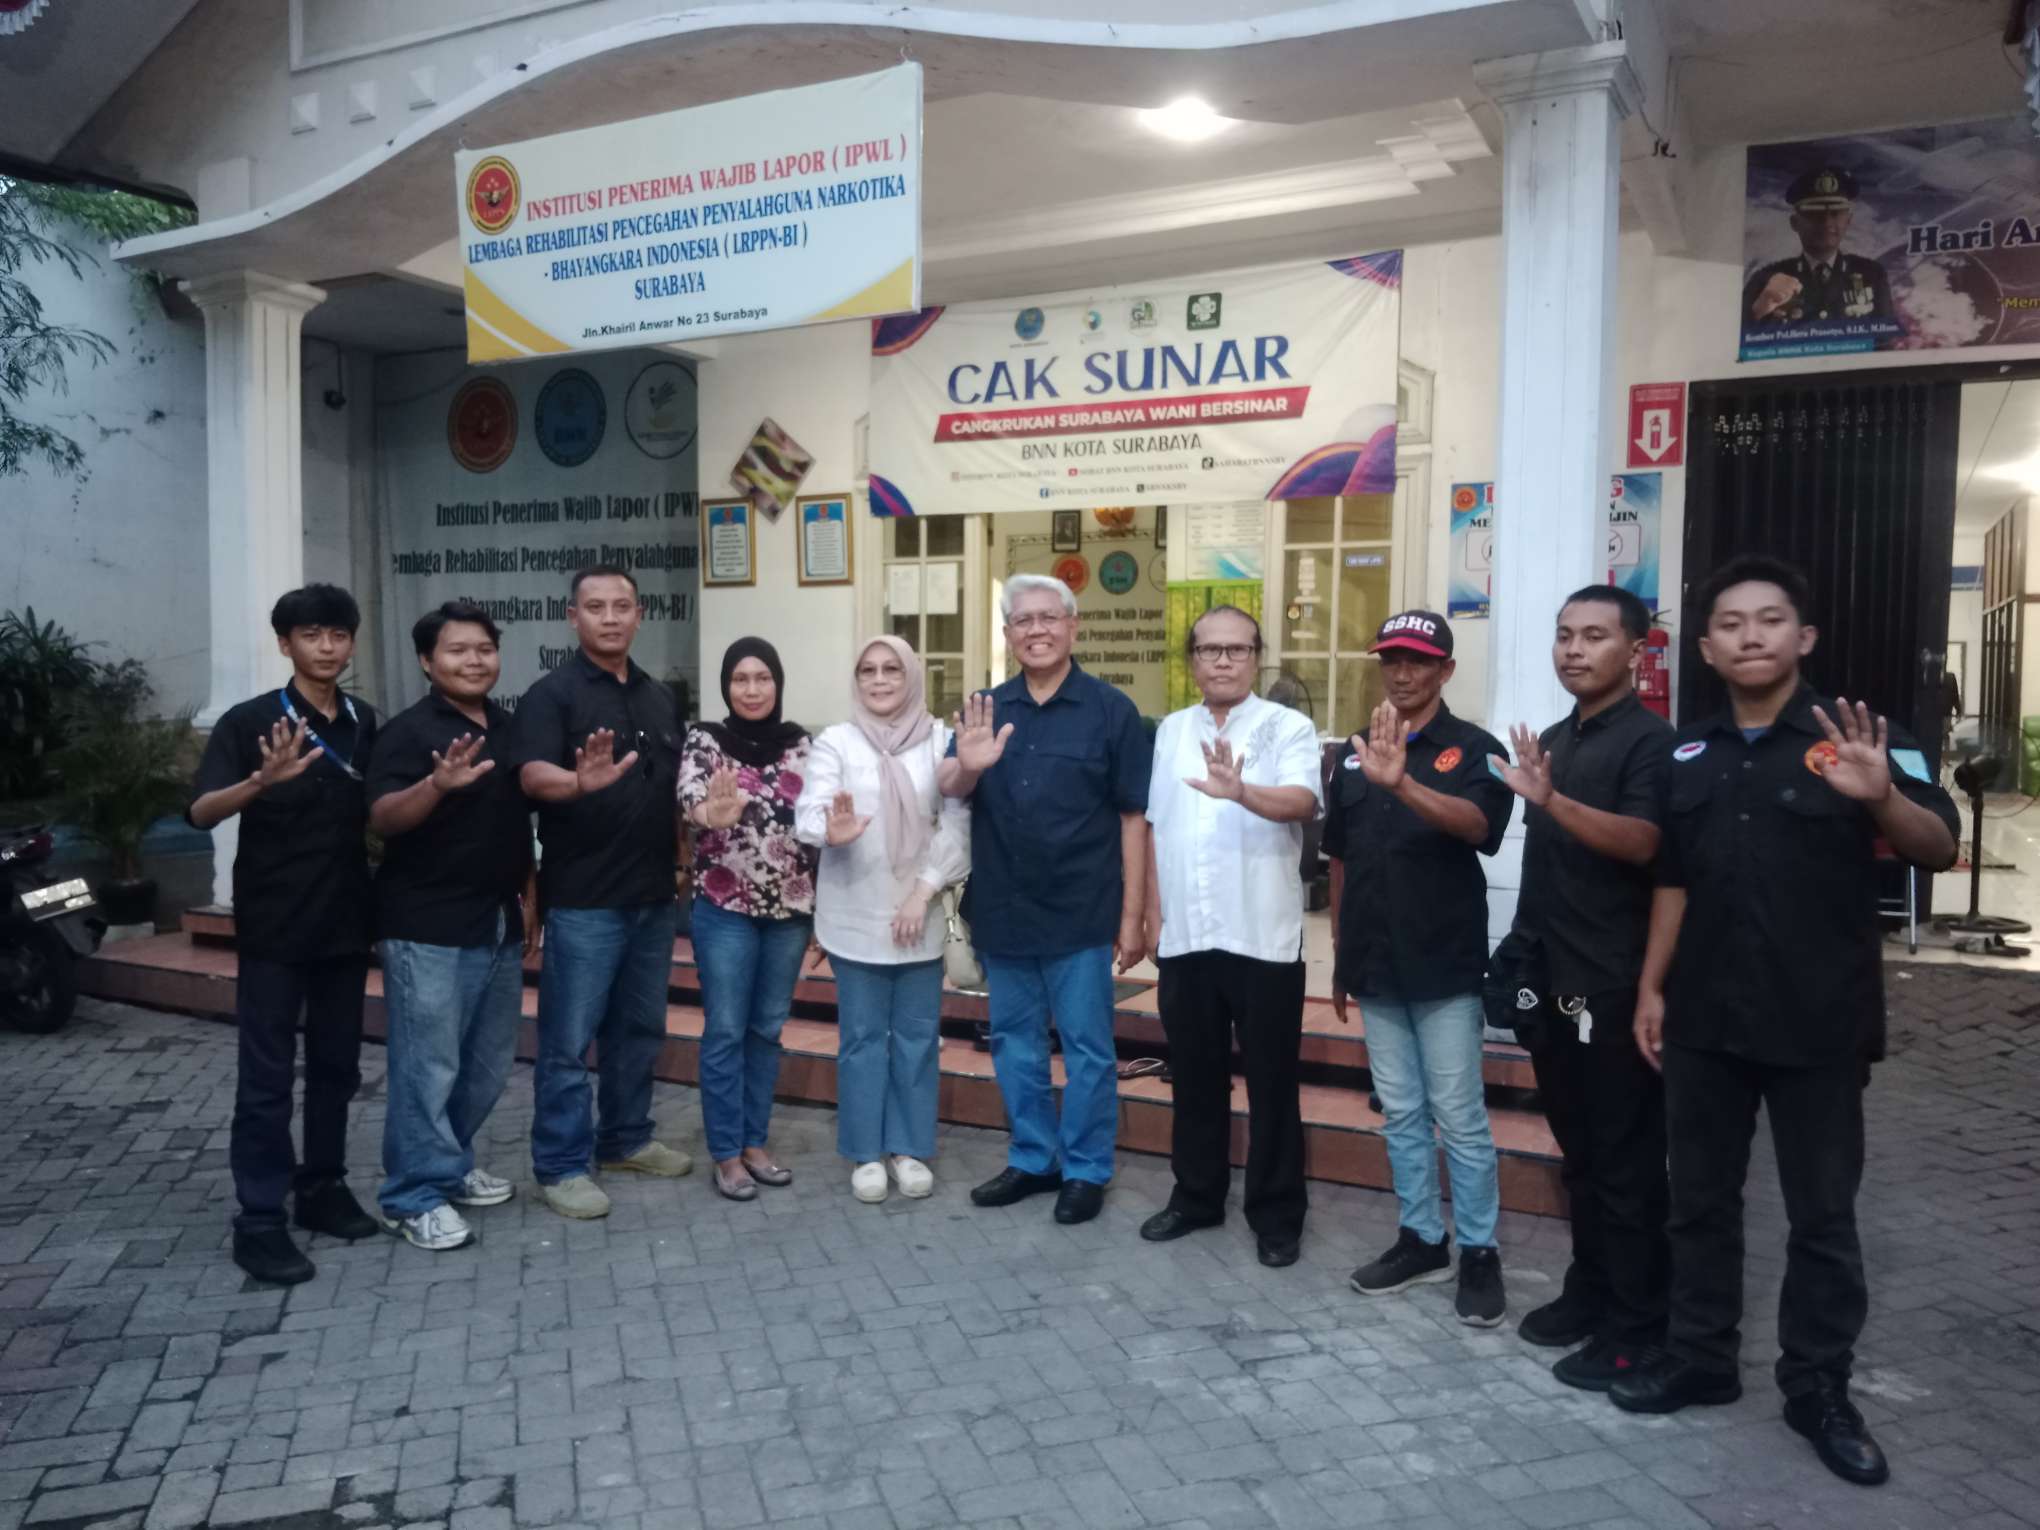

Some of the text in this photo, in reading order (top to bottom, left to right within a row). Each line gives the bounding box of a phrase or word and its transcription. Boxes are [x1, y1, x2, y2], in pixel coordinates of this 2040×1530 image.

[527, 190, 603, 222] INSTITUSI
[608, 174, 695, 207] PENERIMA
[699, 162, 757, 190] WAJIB
[763, 150, 826, 181] LAPOR
[468, 174, 906, 265] LEMBAGA REHABILITASI PENCEGAHAN PENYALAHGUNA NARKOTIKA
[1907, 216, 2040, 255] Hari A
[551, 249, 643, 281] BHAYANGKARA
[647, 237, 720, 267] INDONESIA
[634, 271, 706, 300] SURABAYA
[639, 319, 674, 332] Anwar
[677, 315, 692, 327] No
[696, 312, 710, 325] 23
[713, 306, 769, 323] Surabaya
[947, 334, 1292, 405] CAK SUNAR
[951, 396, 1288, 435] CANGKRUKAN SURABAYA WANI BERSINAR
[1021, 433, 1203, 461] BNN KOTA SURABAYA
[436, 501, 490, 528] Institusi
[492, 498, 559, 526] Penerima
[564, 495, 602, 524] Wajib
[606, 494, 650, 522] Lapor
[445, 547, 518, 574] Rehabilitasi
[521, 545, 597, 571] Pencegahan
